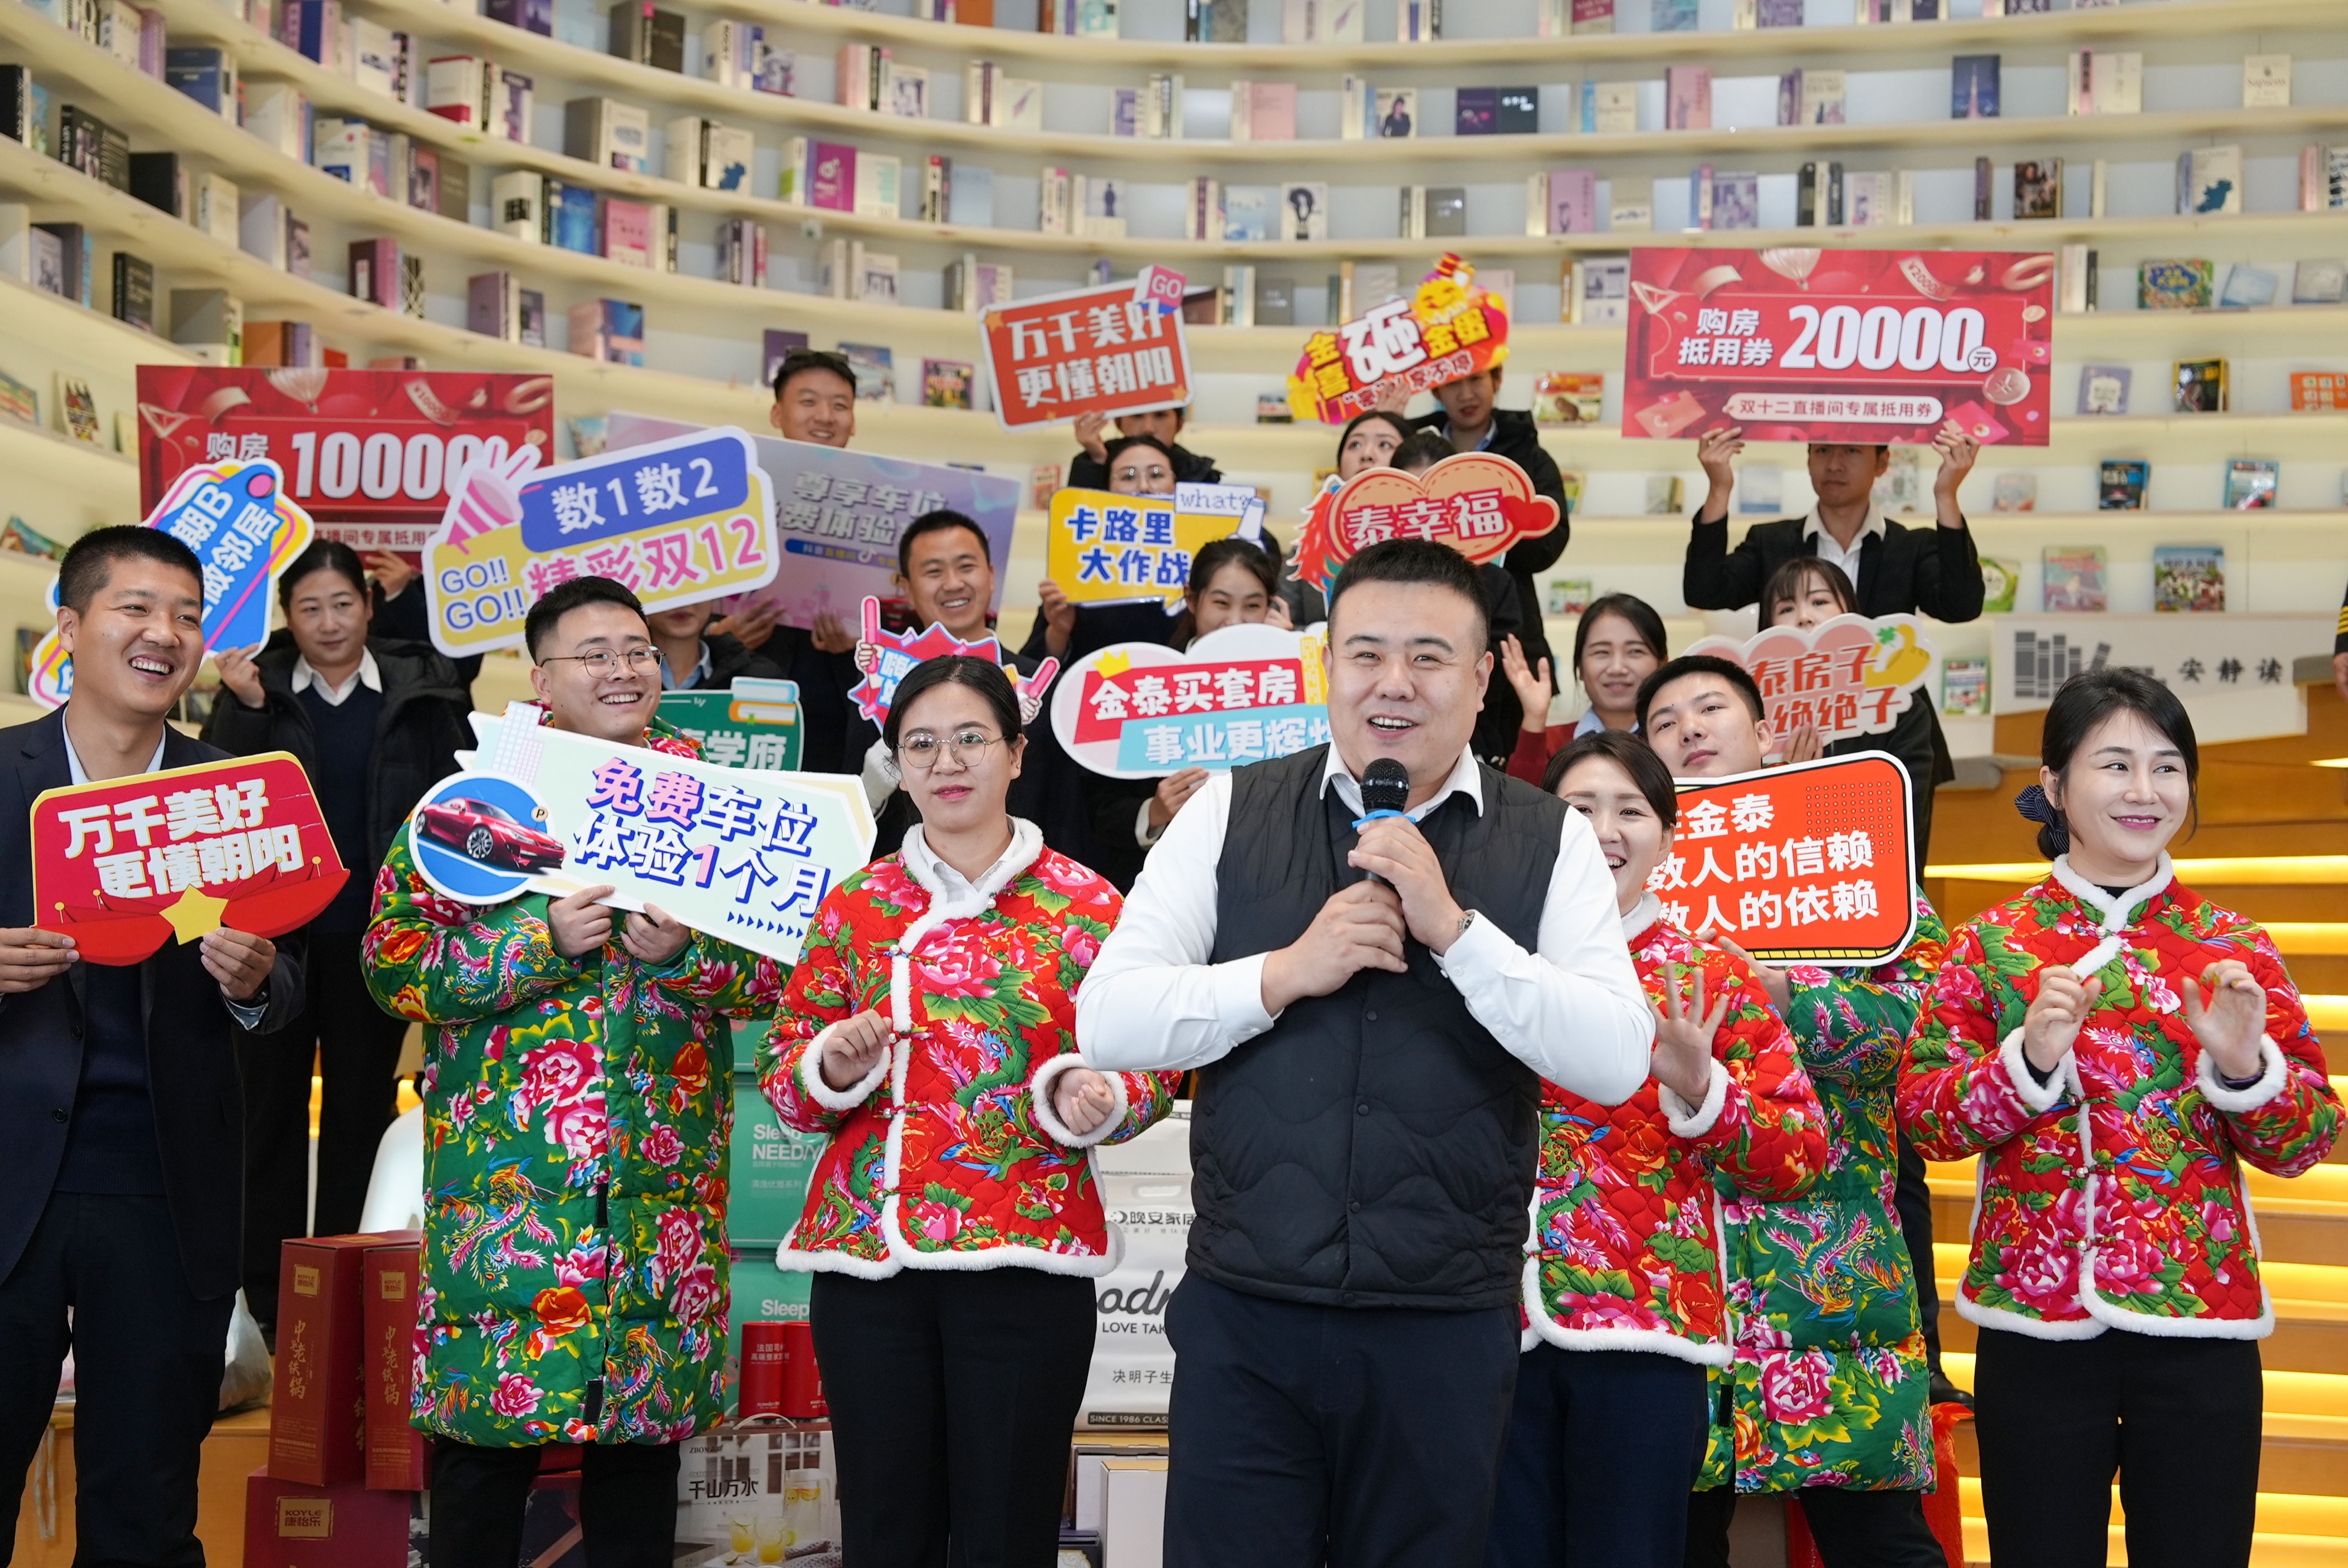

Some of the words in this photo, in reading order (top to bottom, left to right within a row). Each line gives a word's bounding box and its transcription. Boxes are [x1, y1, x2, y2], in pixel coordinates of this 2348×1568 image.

[1152, 274, 1182, 298] GO
[1007, 298, 1165, 362] 万千美好
[1341, 299, 1428, 383] 砸
[1696, 308, 1760, 336] 购房
[1779, 304, 1985, 372] 20000
[1973, 350, 1993, 367] 元
[1678, 337, 1773, 366] 抵用券
[1015, 346, 1176, 408] 更懂朝阳
[1739, 399, 1932, 418] 双十二直播间专属抵用券
[206, 432, 269, 460] 购房
[551, 457, 719, 534] 数1数2
[792, 471, 947, 518] 尊享车位
[775, 500, 915, 546] 费体验
[1068, 508, 1172, 545] 卡路里
[1347, 491, 1504, 550] 泰幸福
[201, 501, 280, 622] 做邻居
[440, 558, 508, 594] GO!!
[528, 517, 763, 602] 精彩双12
[1080, 548, 1190, 585] 大作战
[445, 587, 526, 630] GO!!
[2178, 657, 2282, 684] 安静读
[1089, 664, 1297, 721] 金泰买套房
[1773, 686, 1902, 740] 绝绝子
[683, 728, 787, 770] 学府
[58, 778, 269, 859] 万千美好
[587, 756, 818, 858] 免费车位
[93, 824, 305, 902] 更懂朝阳
[573, 810, 831, 918] 体验1个月
[1645, 829, 1875, 892] 数人的信赖
[753, 1123, 802, 1140] Slep
[761, 1299, 810, 1321] Sleep
[1102, 1322, 1138, 1334] LOVE
[1112, 1369, 1173, 1384] 决明子生
[1089, 1414, 1116, 1423] SINCE
[1119, 1415, 1140, 1424] 1986
[689, 1476, 759, 1499] 千山万水
[284, 1517, 321, 1527] 康怡乐
